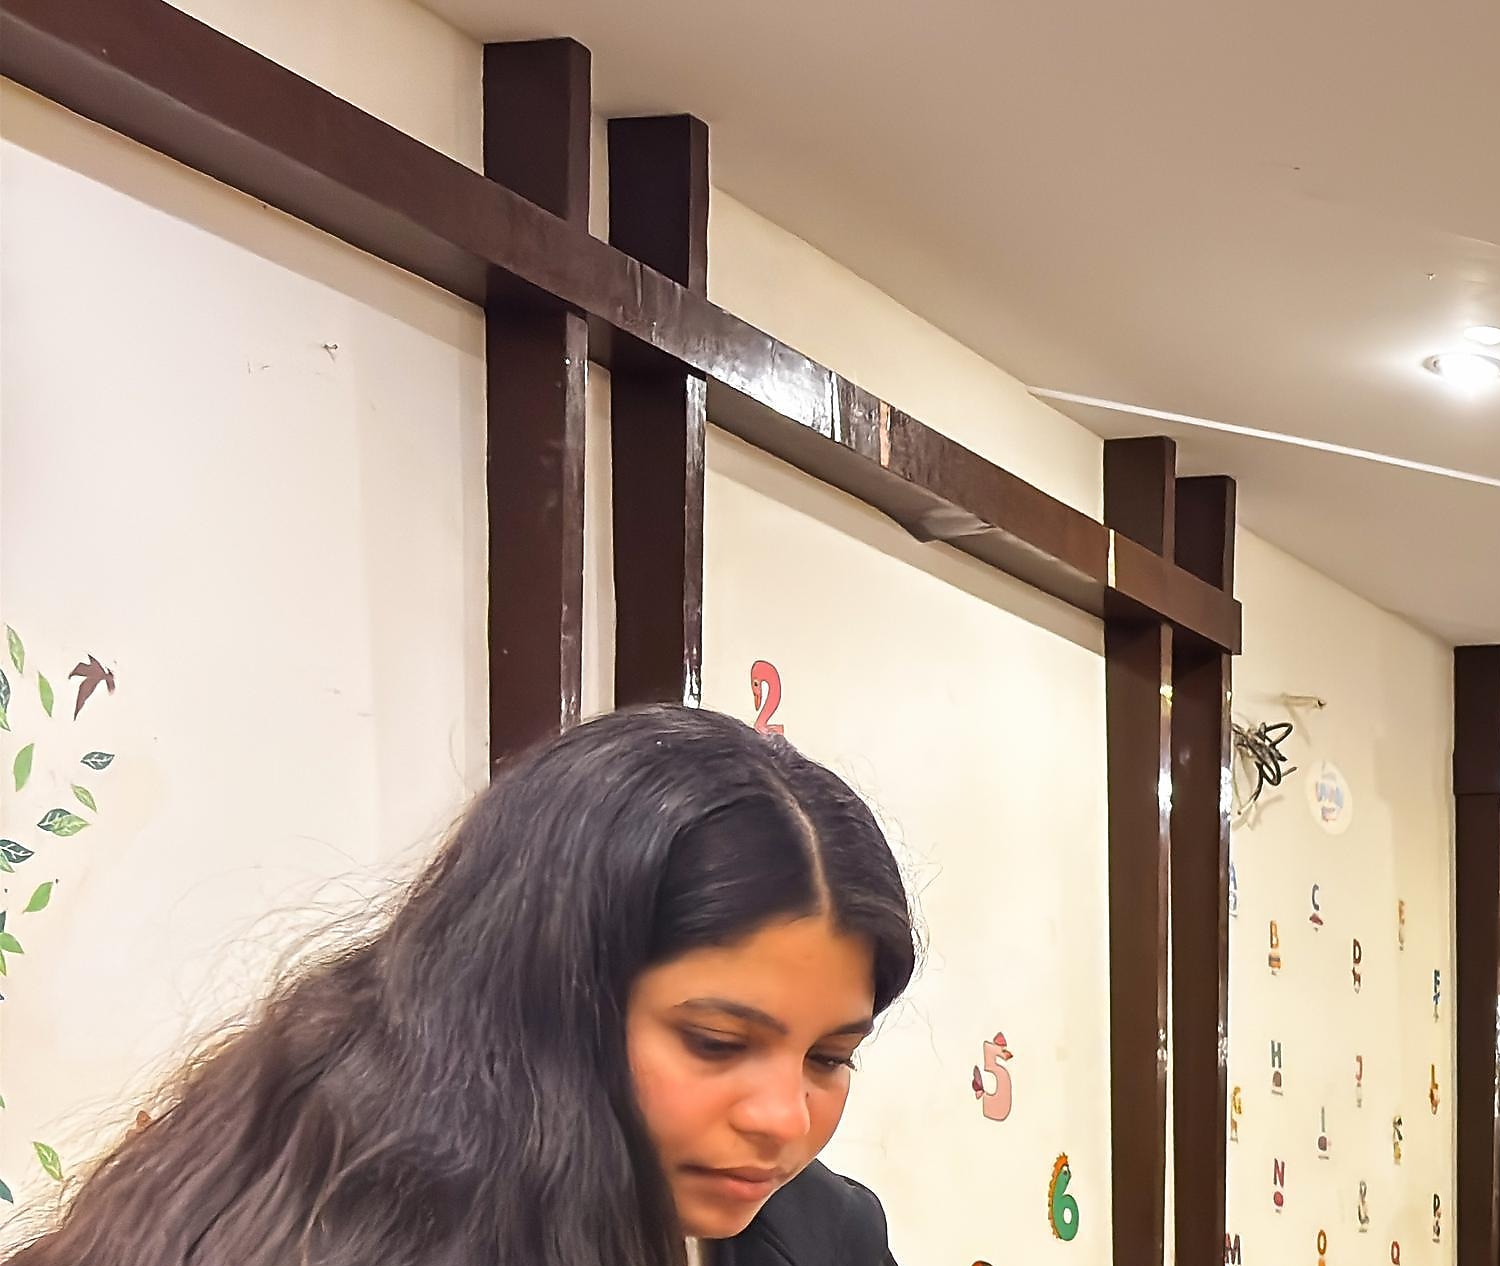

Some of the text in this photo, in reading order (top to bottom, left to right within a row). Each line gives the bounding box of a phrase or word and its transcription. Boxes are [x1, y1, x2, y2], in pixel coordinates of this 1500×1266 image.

[751, 660, 784, 735] 2
[1312, 884, 1319, 911] C
[1353, 938, 1362, 964] D
[1271, 1040, 1282, 1069] H
[972, 1032, 1013, 1122] 5
[1273, 1158, 1285, 1188] N
[1048, 1153, 1079, 1241] 6
[1224, 1232, 1241, 1265] M
[1391, 1241, 1400, 1266] Q
